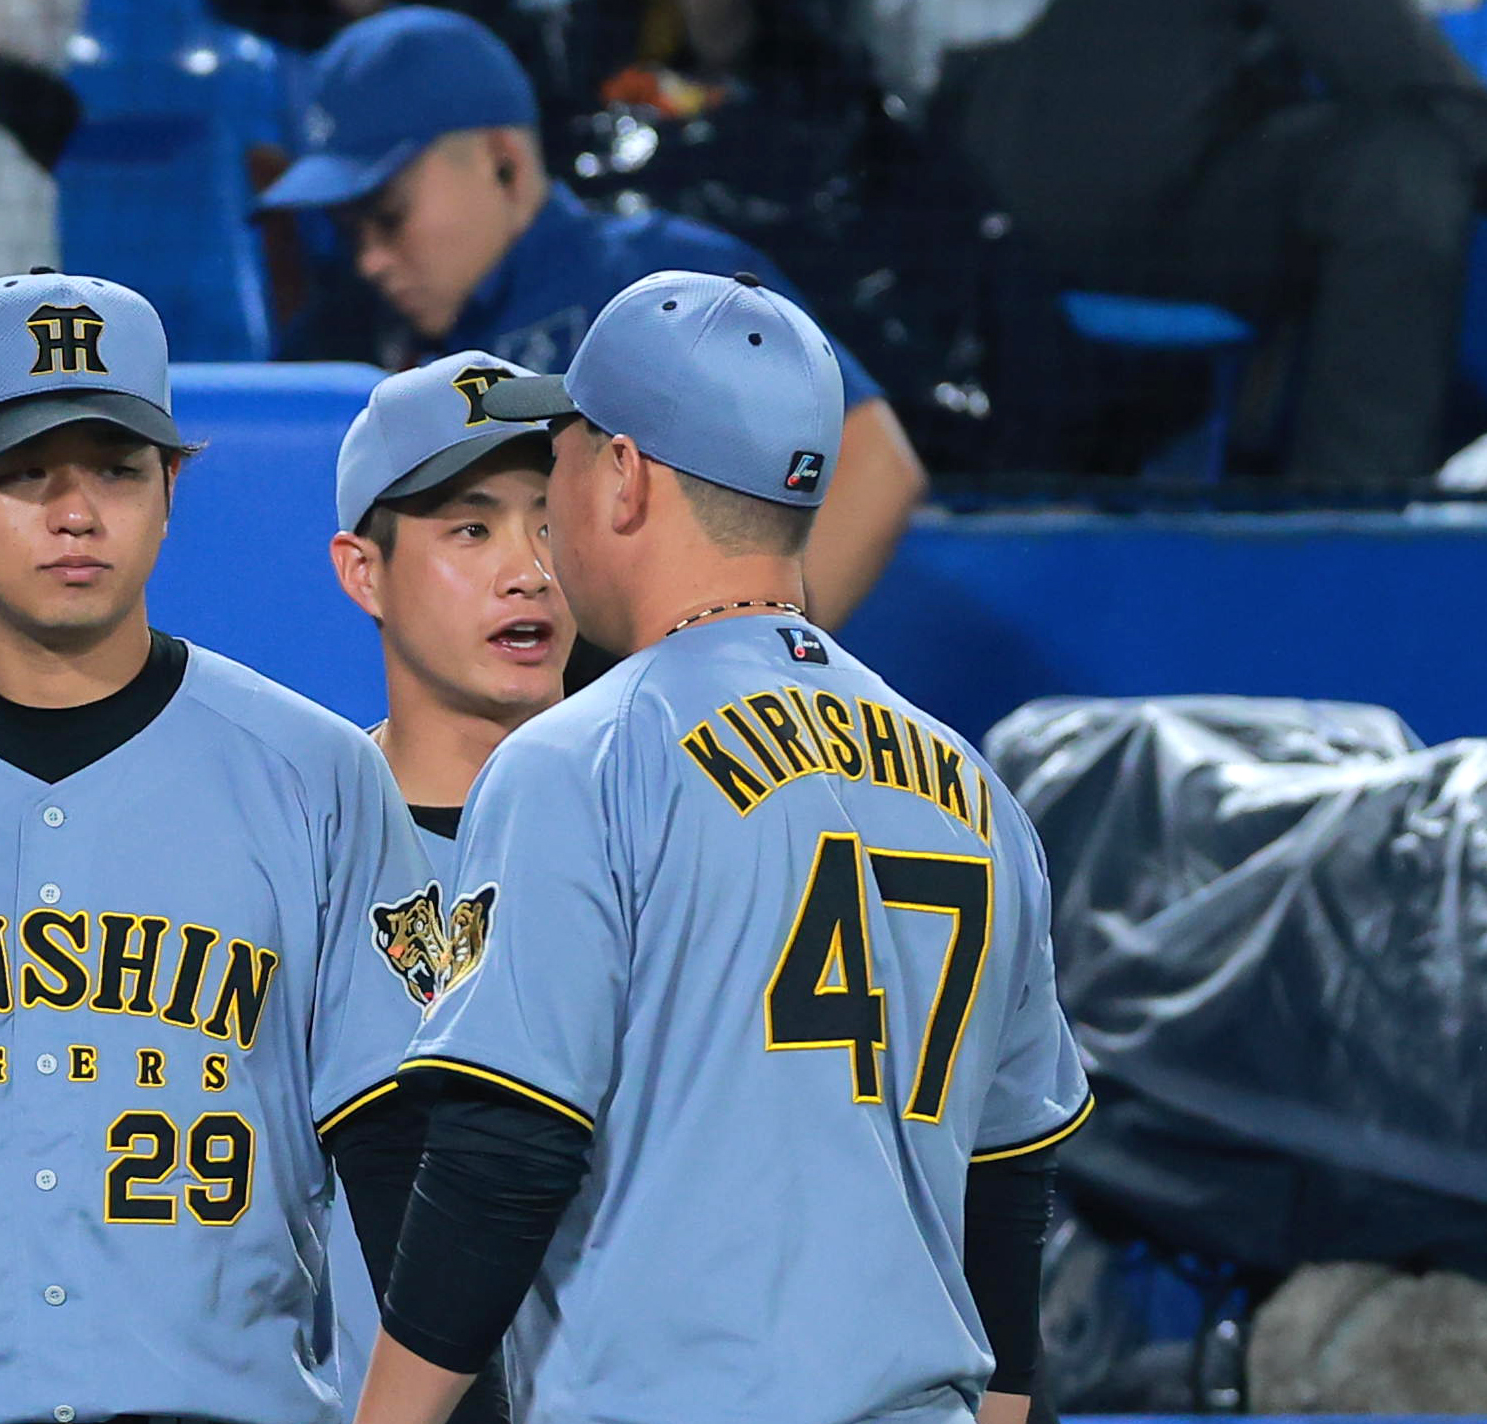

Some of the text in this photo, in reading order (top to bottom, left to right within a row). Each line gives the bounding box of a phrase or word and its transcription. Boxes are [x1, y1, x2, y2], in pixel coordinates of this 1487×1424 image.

[679, 687, 993, 849] KIRISHIKI
[764, 831, 994, 1124] 47
[104, 1110, 256, 1227] 29
